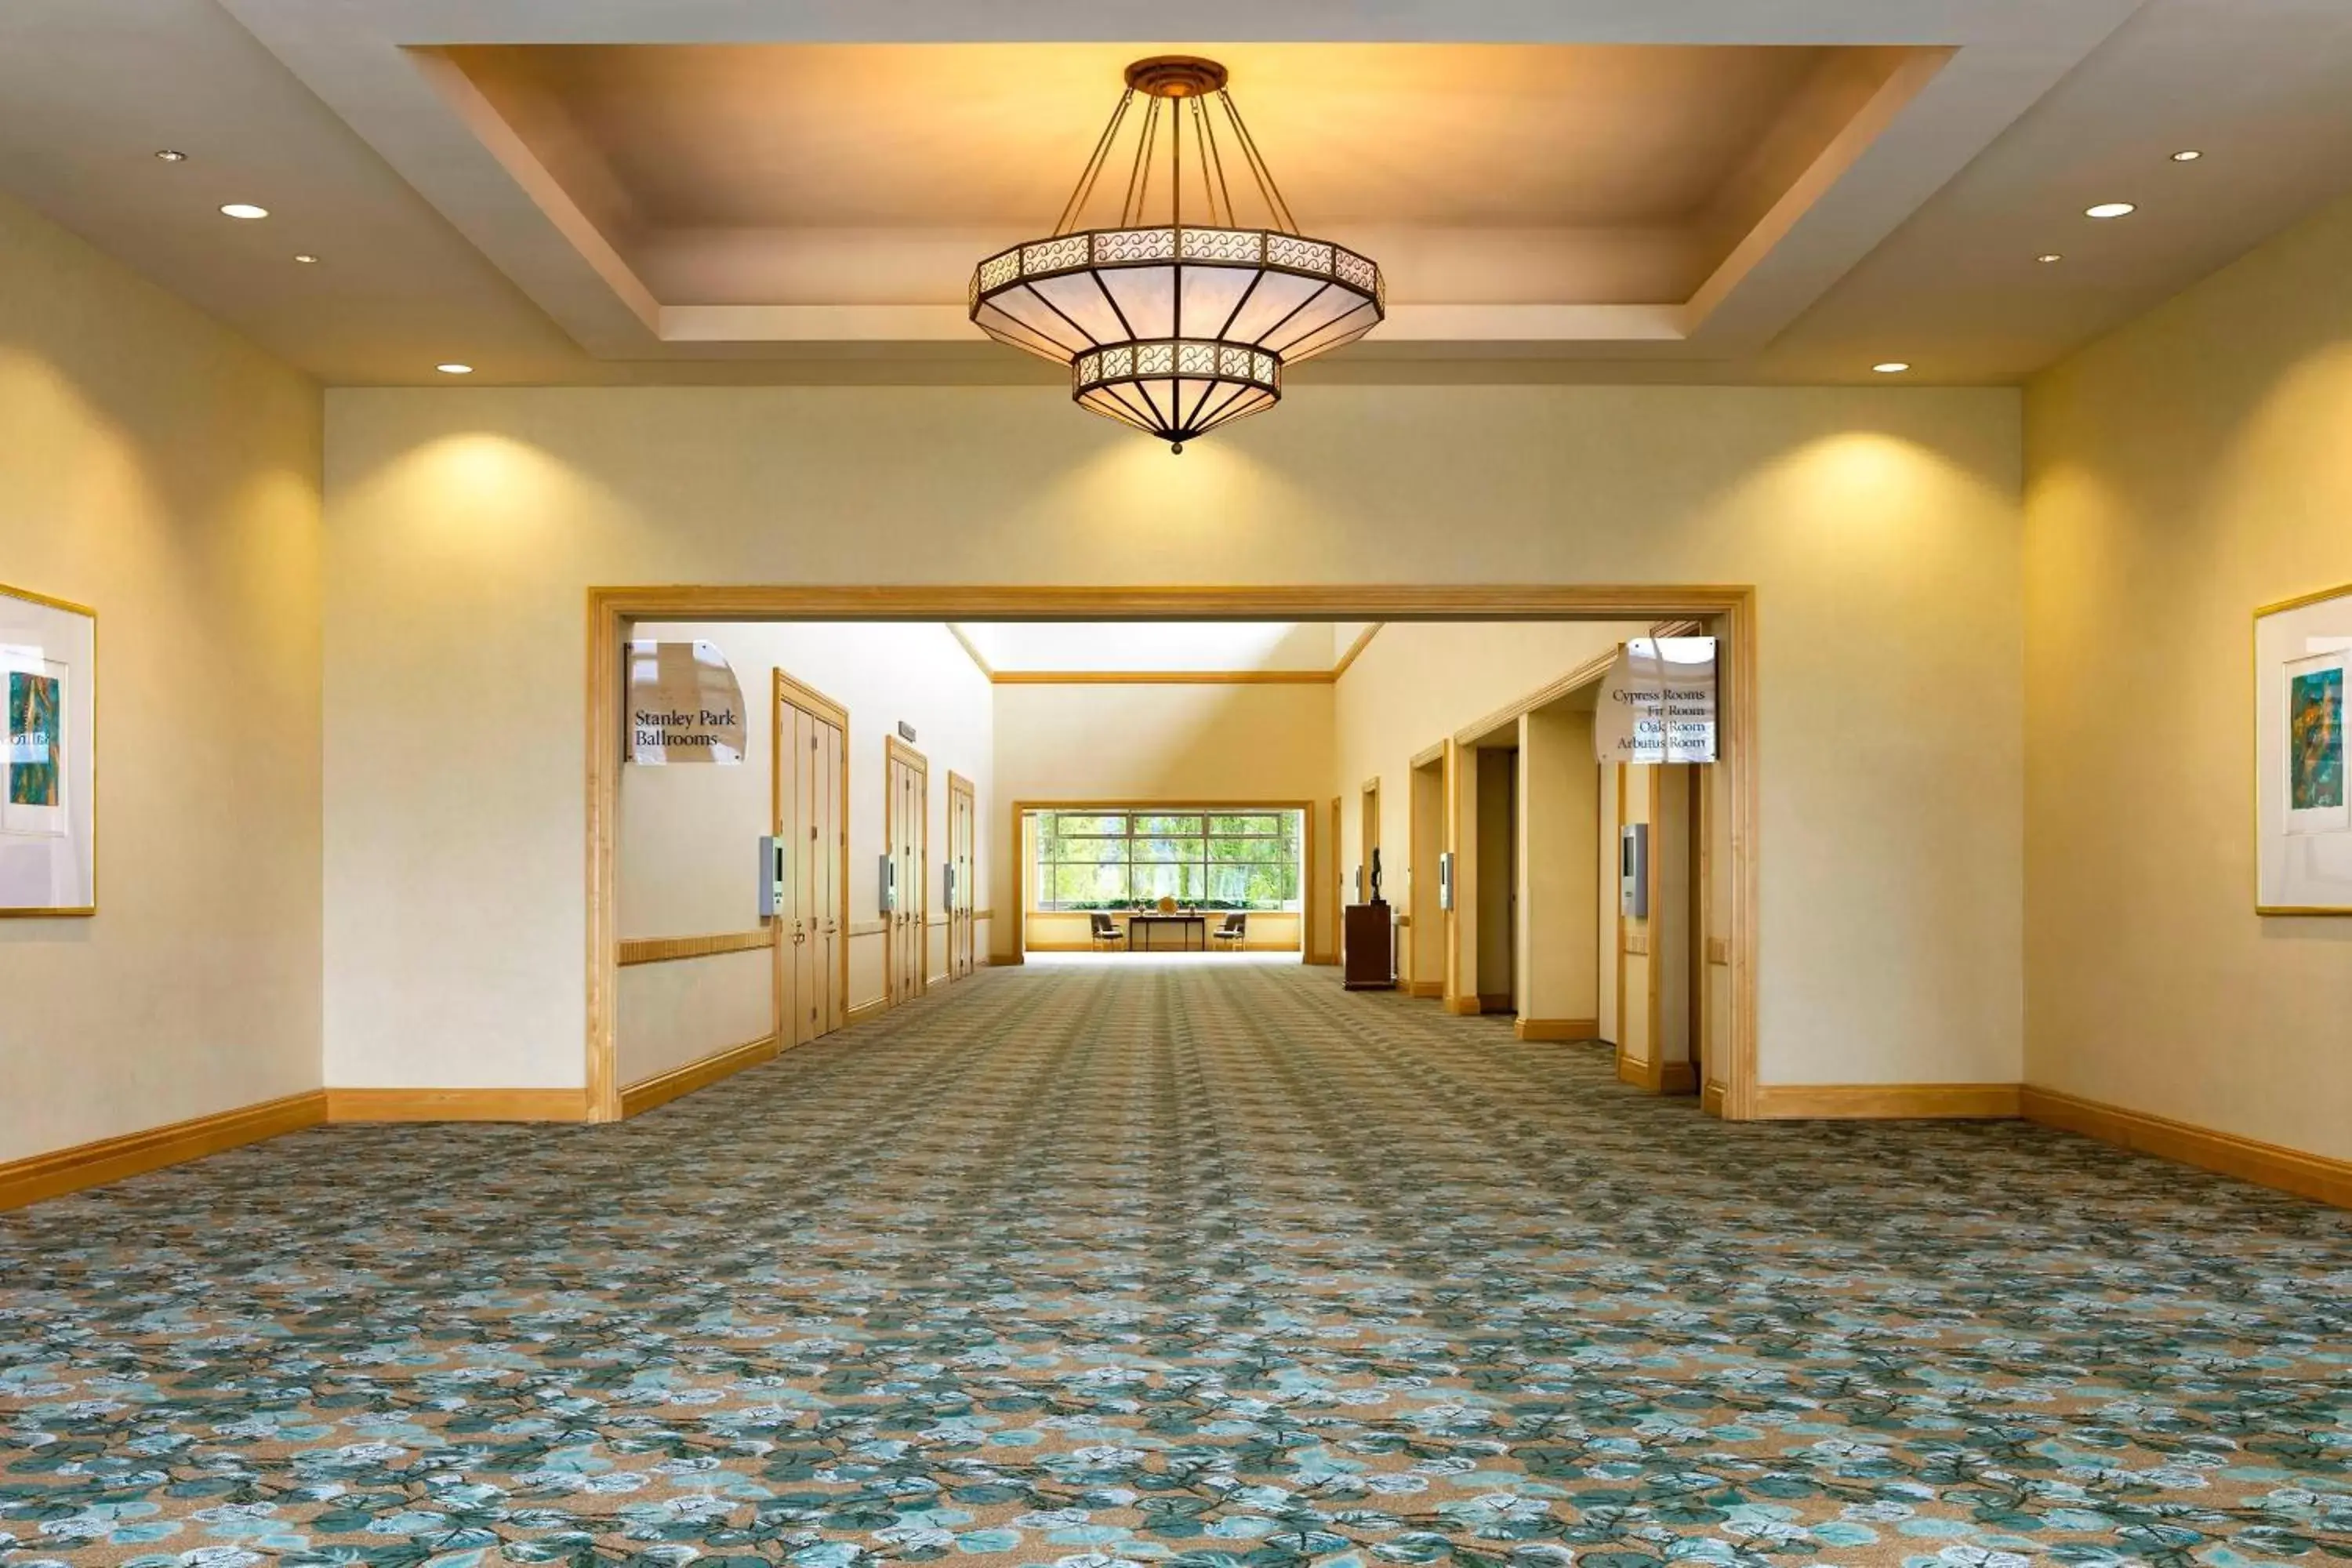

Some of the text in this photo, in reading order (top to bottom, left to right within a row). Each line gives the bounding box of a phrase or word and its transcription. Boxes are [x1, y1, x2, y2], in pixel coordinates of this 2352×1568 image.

[1613, 689, 1706, 705] Cypress Rooms
[1648, 705, 1706, 717] Fir Room
[635, 709, 736, 729] Stanley Park
[1639, 720, 1706, 733] Oak Room
[636, 730, 718, 746] Ballrooms
[1617, 736, 1706, 750] Arbutus Room
